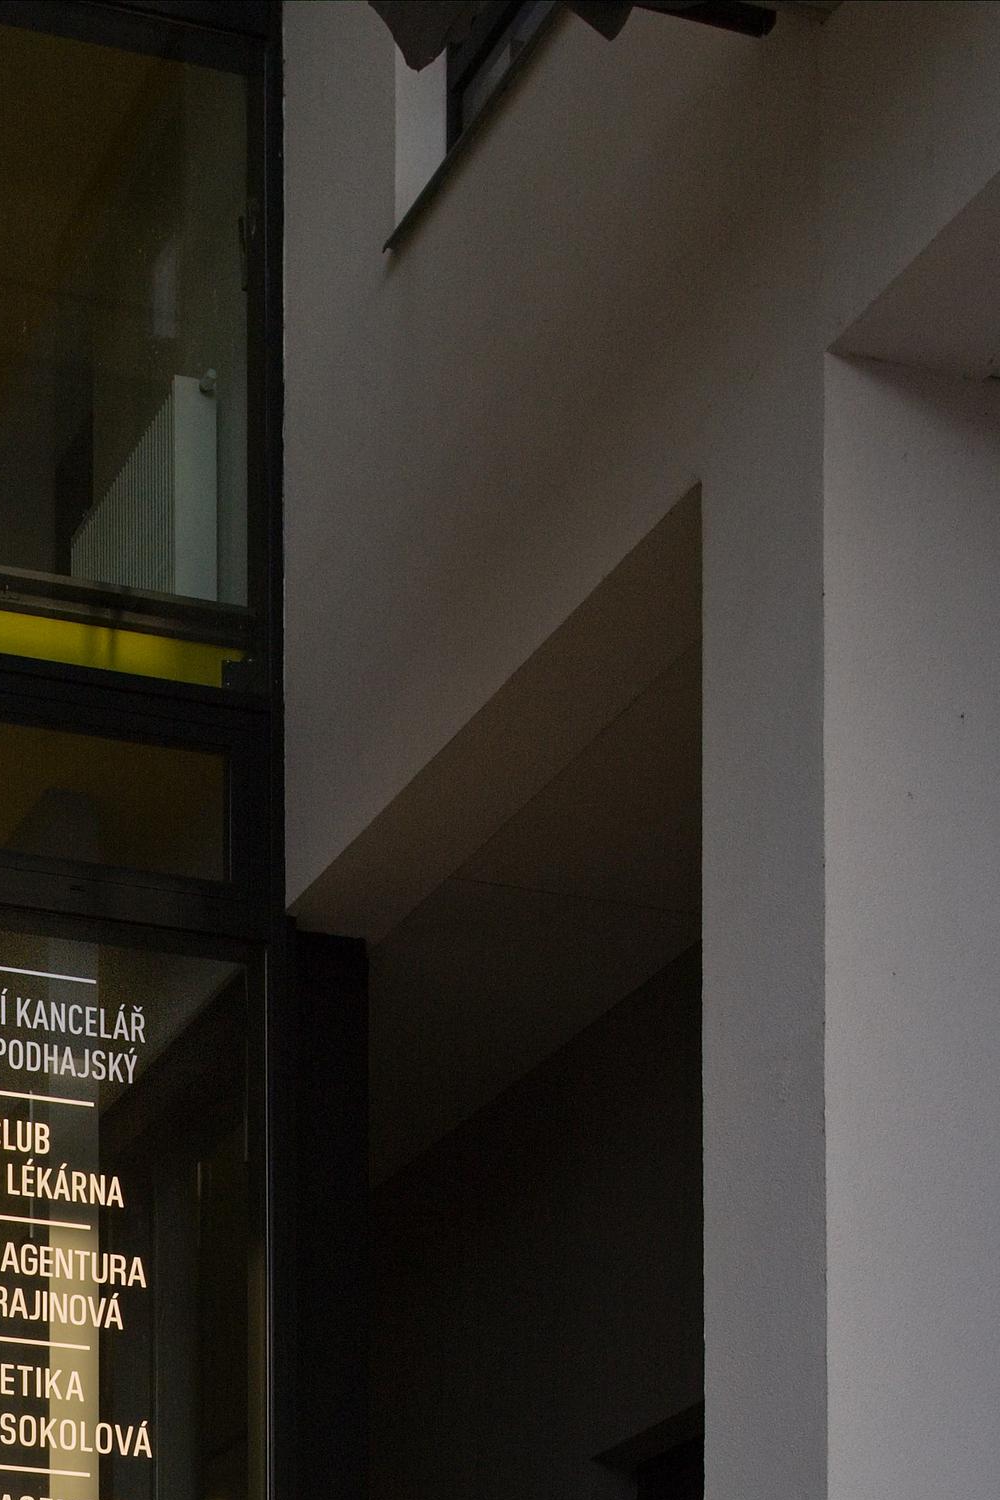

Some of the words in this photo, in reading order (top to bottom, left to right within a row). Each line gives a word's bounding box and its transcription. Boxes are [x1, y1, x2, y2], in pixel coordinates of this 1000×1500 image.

[16, 998, 146, 1043] KANCELÁŘ
[7, 1159, 124, 1208] LÉKÁRNA
[0, 1242, 147, 1288] AGENTURA
[0, 1413, 153, 1459] SOKOLOVÁ
